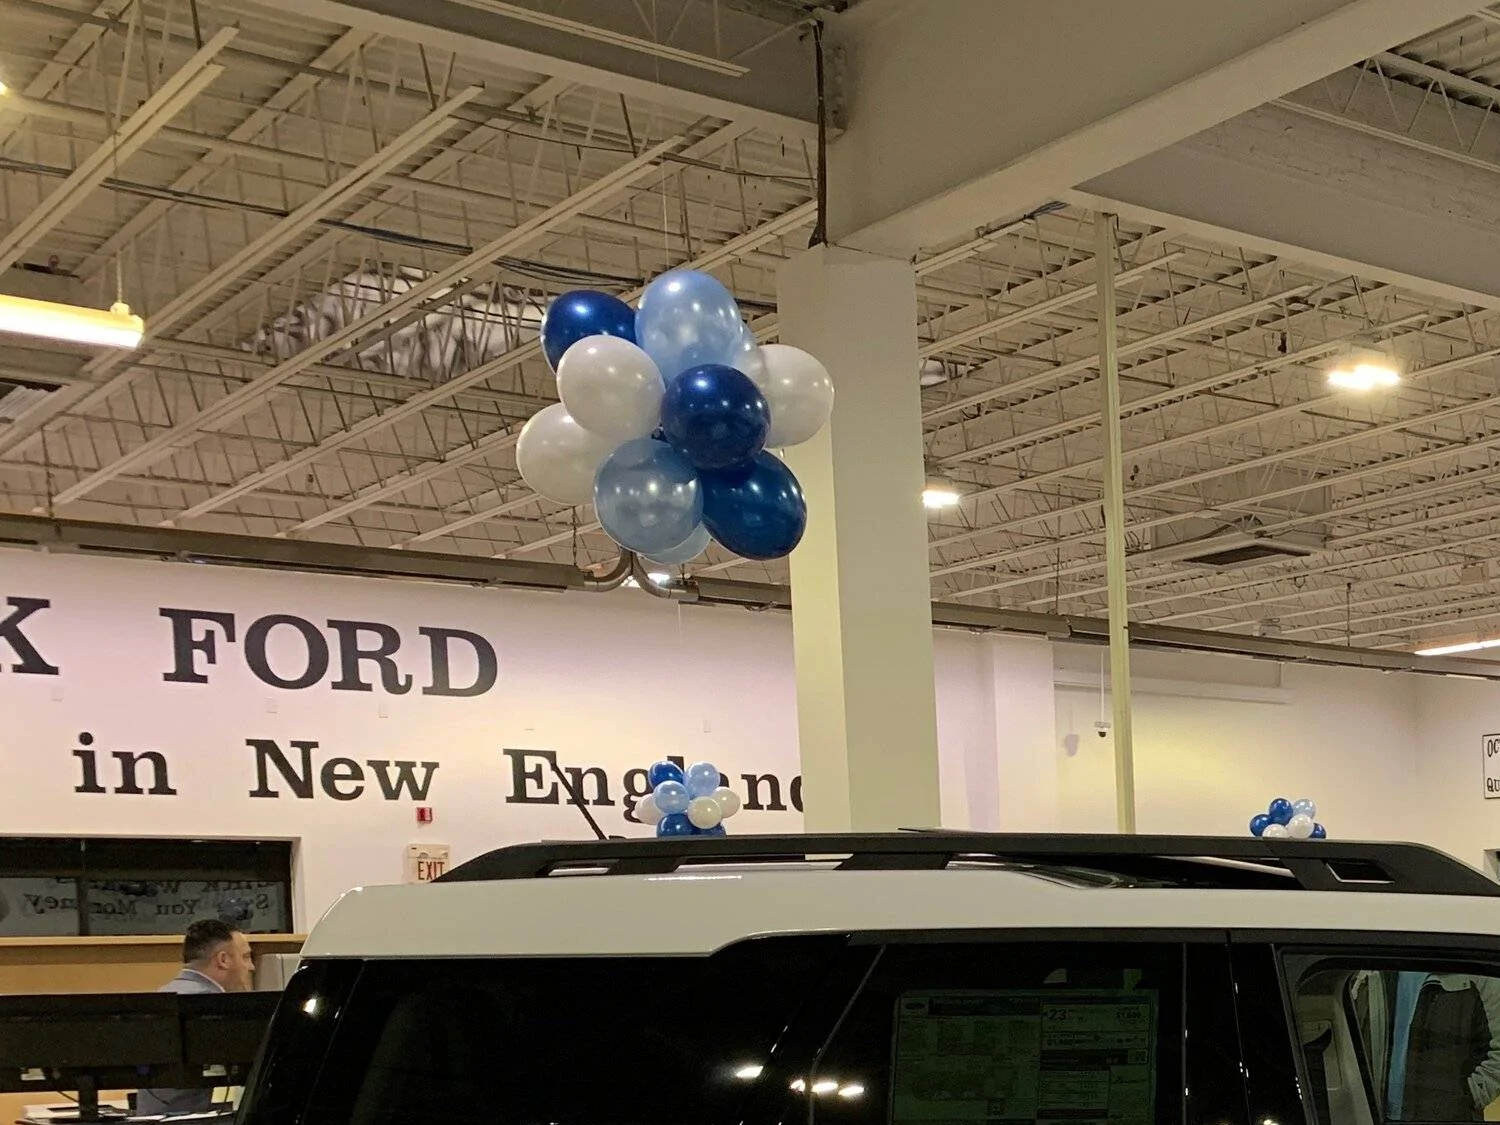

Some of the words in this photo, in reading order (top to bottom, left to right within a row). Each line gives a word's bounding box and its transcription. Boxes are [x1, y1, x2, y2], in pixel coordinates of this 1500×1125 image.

[158, 607, 498, 698] FORD
[72, 731, 177, 796] in
[245, 738, 440, 801] New
[418, 861, 445, 880] EXIT
